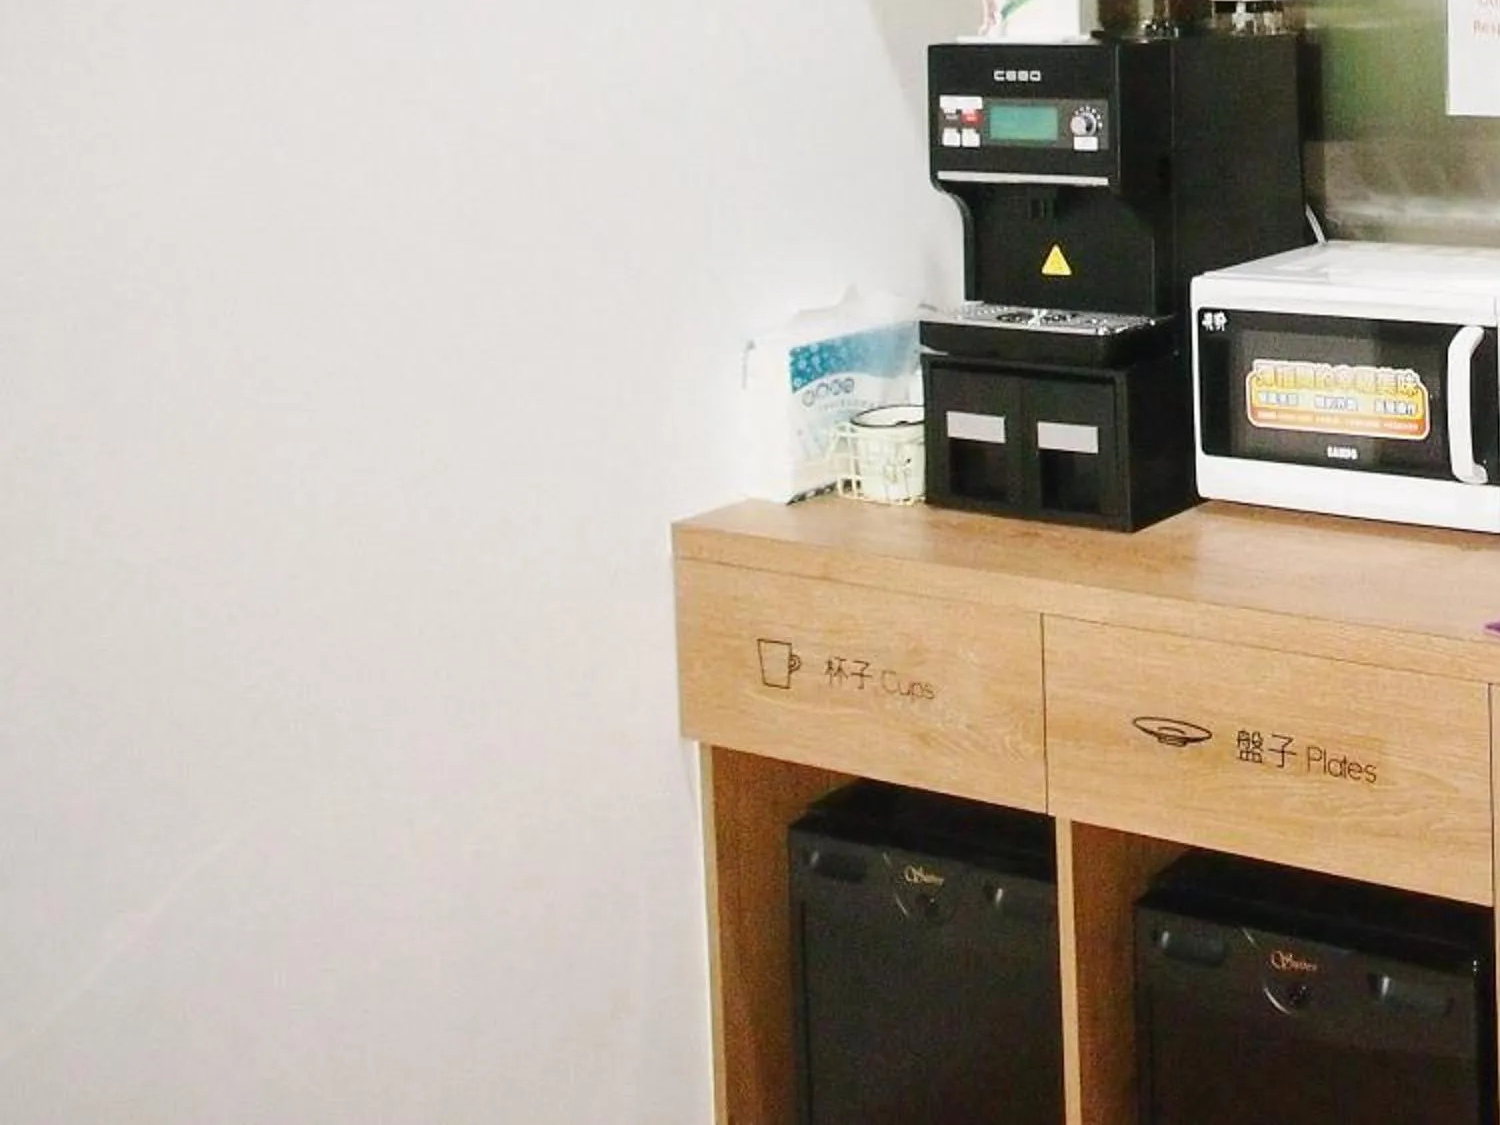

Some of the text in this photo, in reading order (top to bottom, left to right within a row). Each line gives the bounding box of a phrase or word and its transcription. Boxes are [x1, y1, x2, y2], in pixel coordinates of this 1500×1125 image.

[824, 656, 936, 703] 杯子 Cups
[1236, 729, 1378, 784] 盤子 Plates
